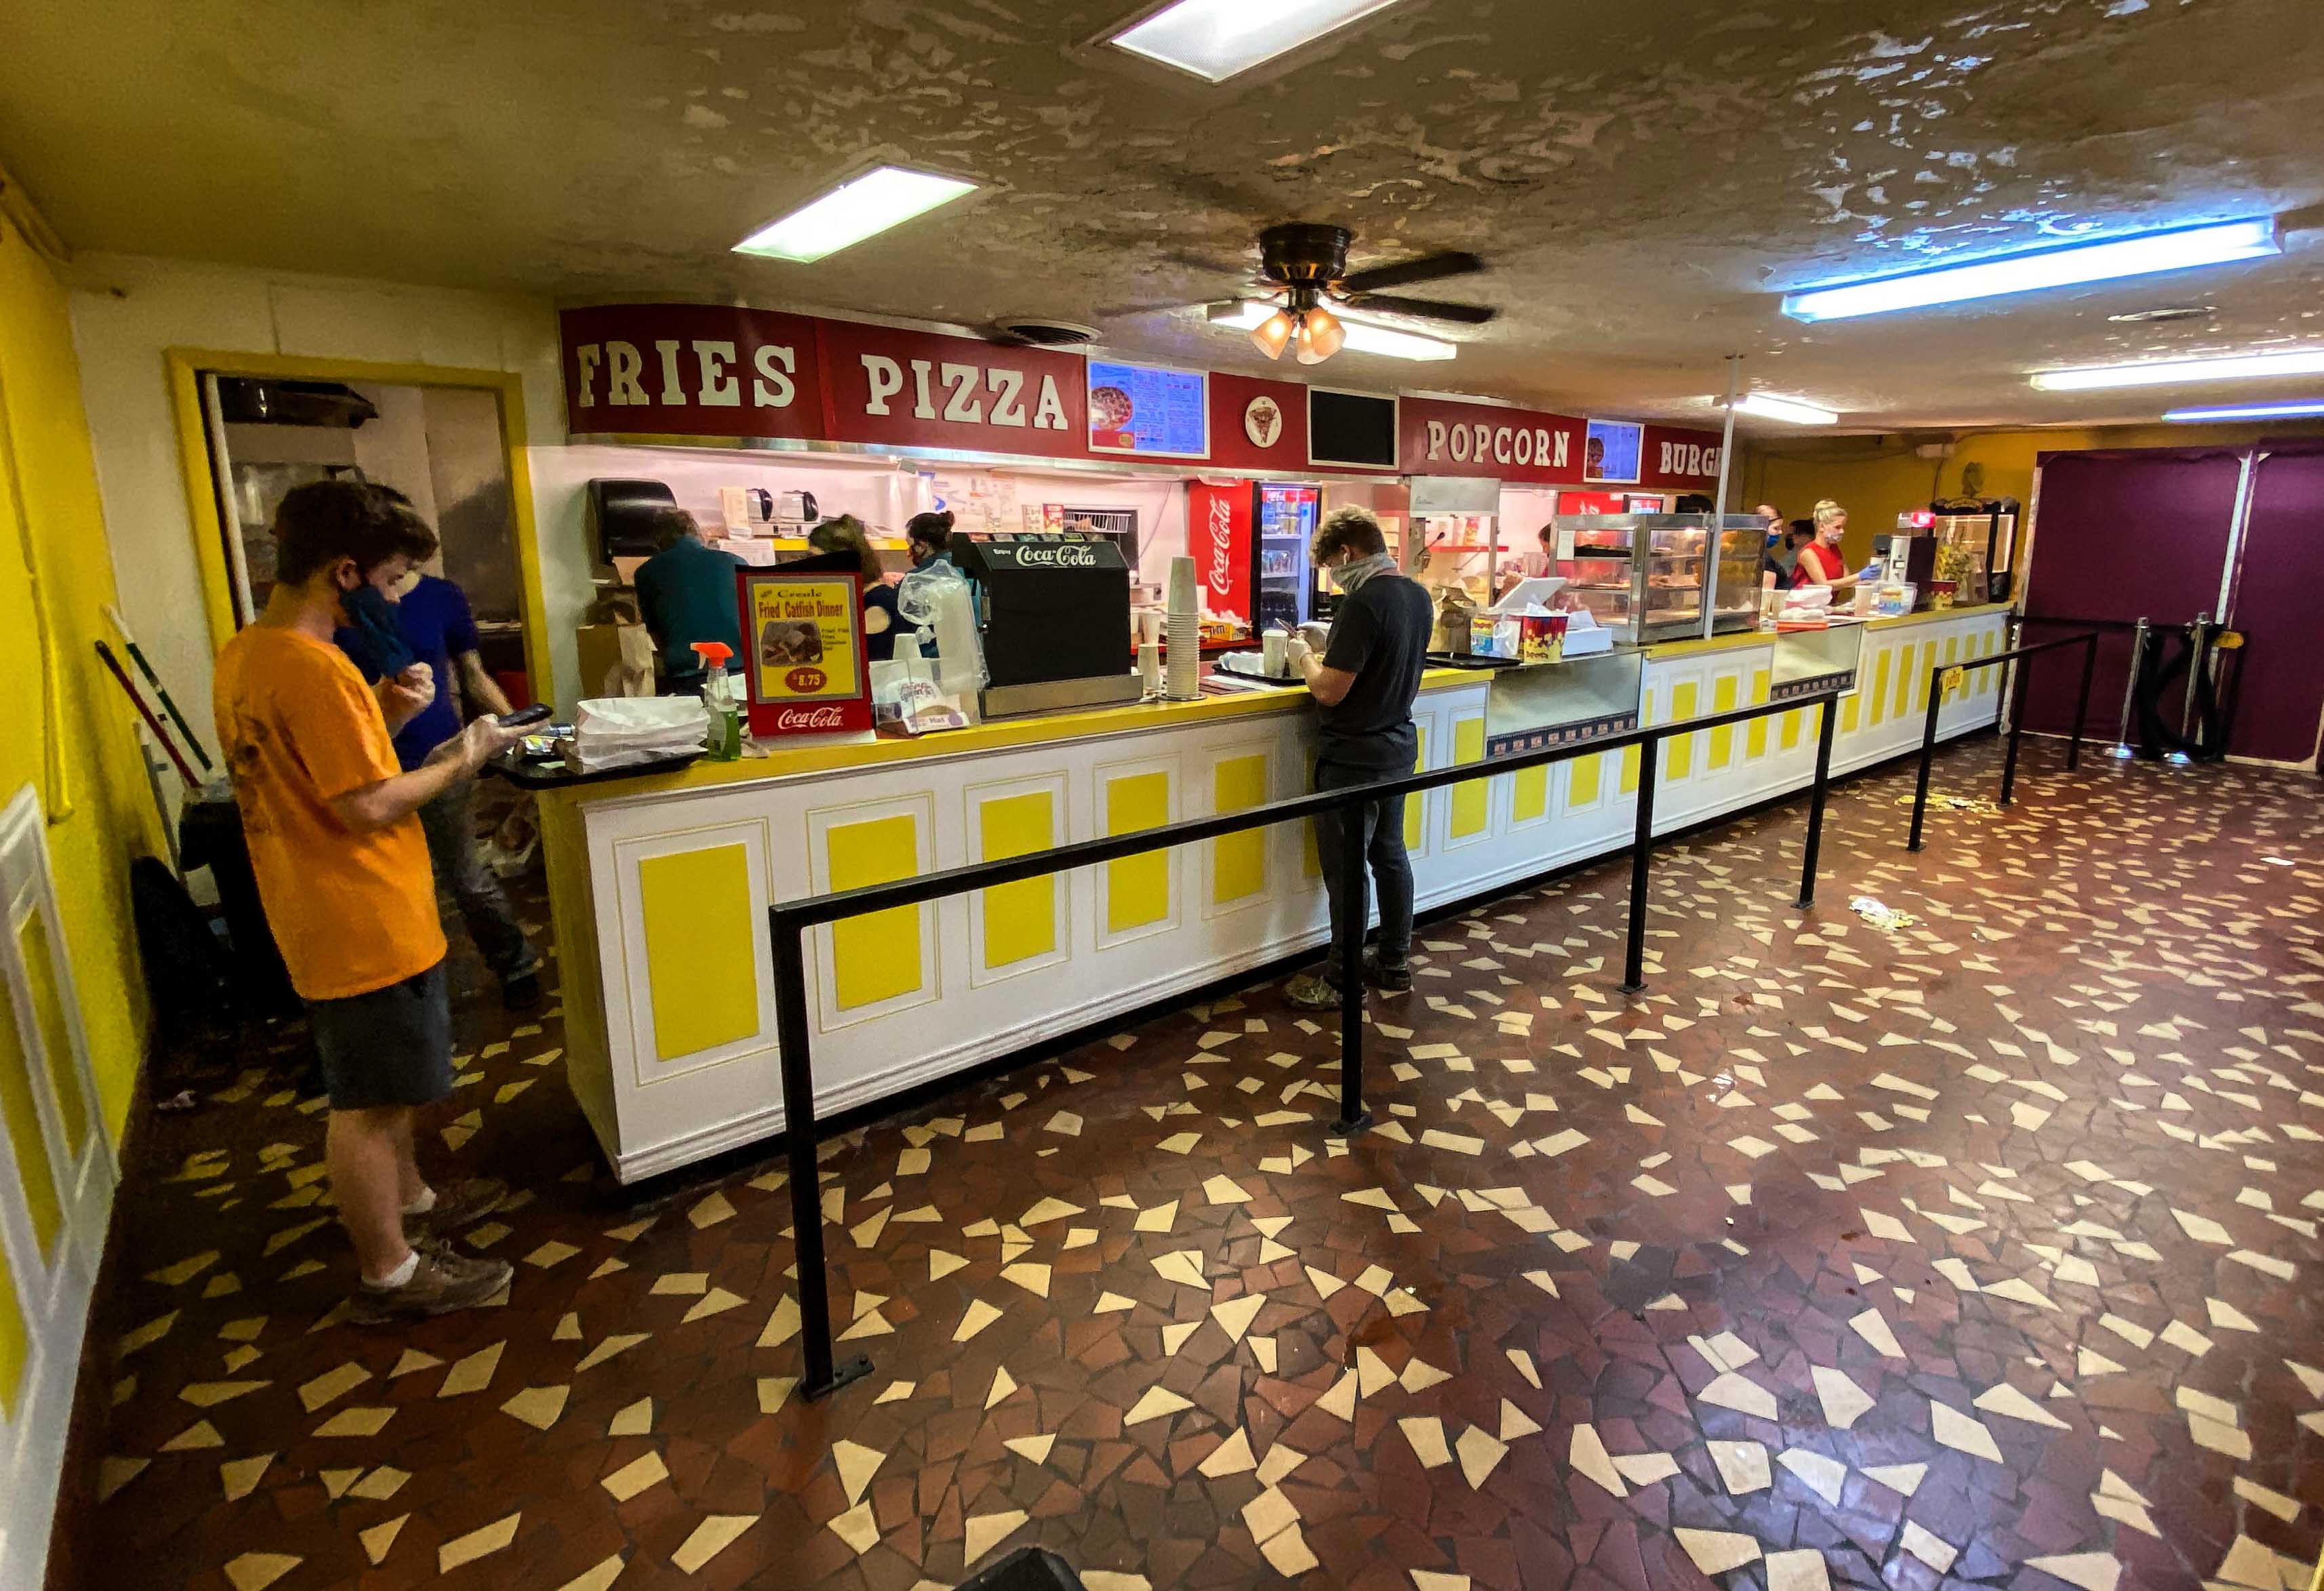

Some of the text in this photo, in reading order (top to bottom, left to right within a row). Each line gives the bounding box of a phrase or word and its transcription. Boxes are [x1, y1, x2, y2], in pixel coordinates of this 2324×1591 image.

[577, 340, 796, 407] FRIES
[860, 353, 1069, 430] PIZZA
[1426, 420, 1570, 468] POPCORN
[1016, 545, 1096, 568] Coca-Cola
[1209, 492, 1232, 596] Coca-Cola
[758, 600, 843, 619] Fried Catfish Dinner
[778, 707, 844, 729] Coca-Cola
